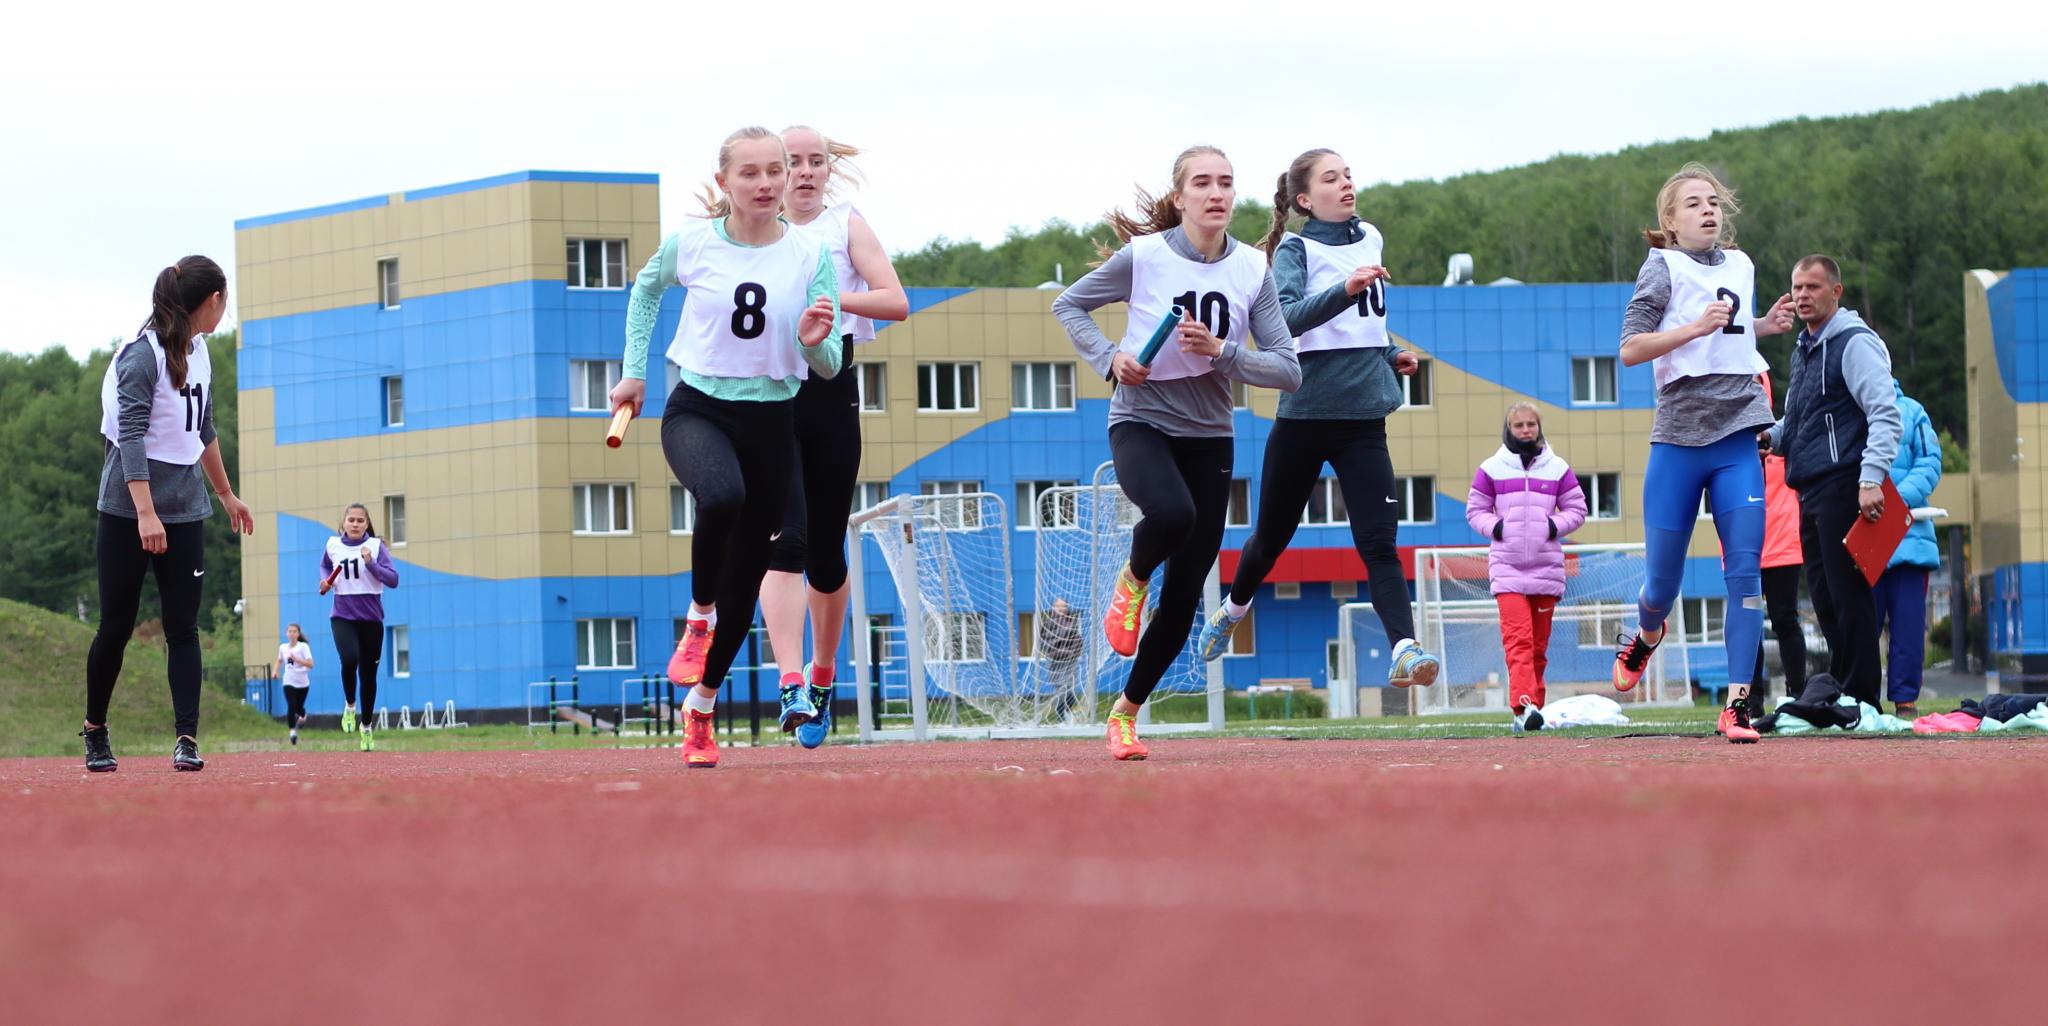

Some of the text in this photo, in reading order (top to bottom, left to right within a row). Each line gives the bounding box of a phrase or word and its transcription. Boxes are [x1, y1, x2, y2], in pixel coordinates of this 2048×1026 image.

[731, 282, 767, 340] 8
[1172, 290, 1230, 340] 10
[1716, 287, 1745, 335] 2
[180, 383, 203, 432] 11
[340, 558, 360, 580] 11
